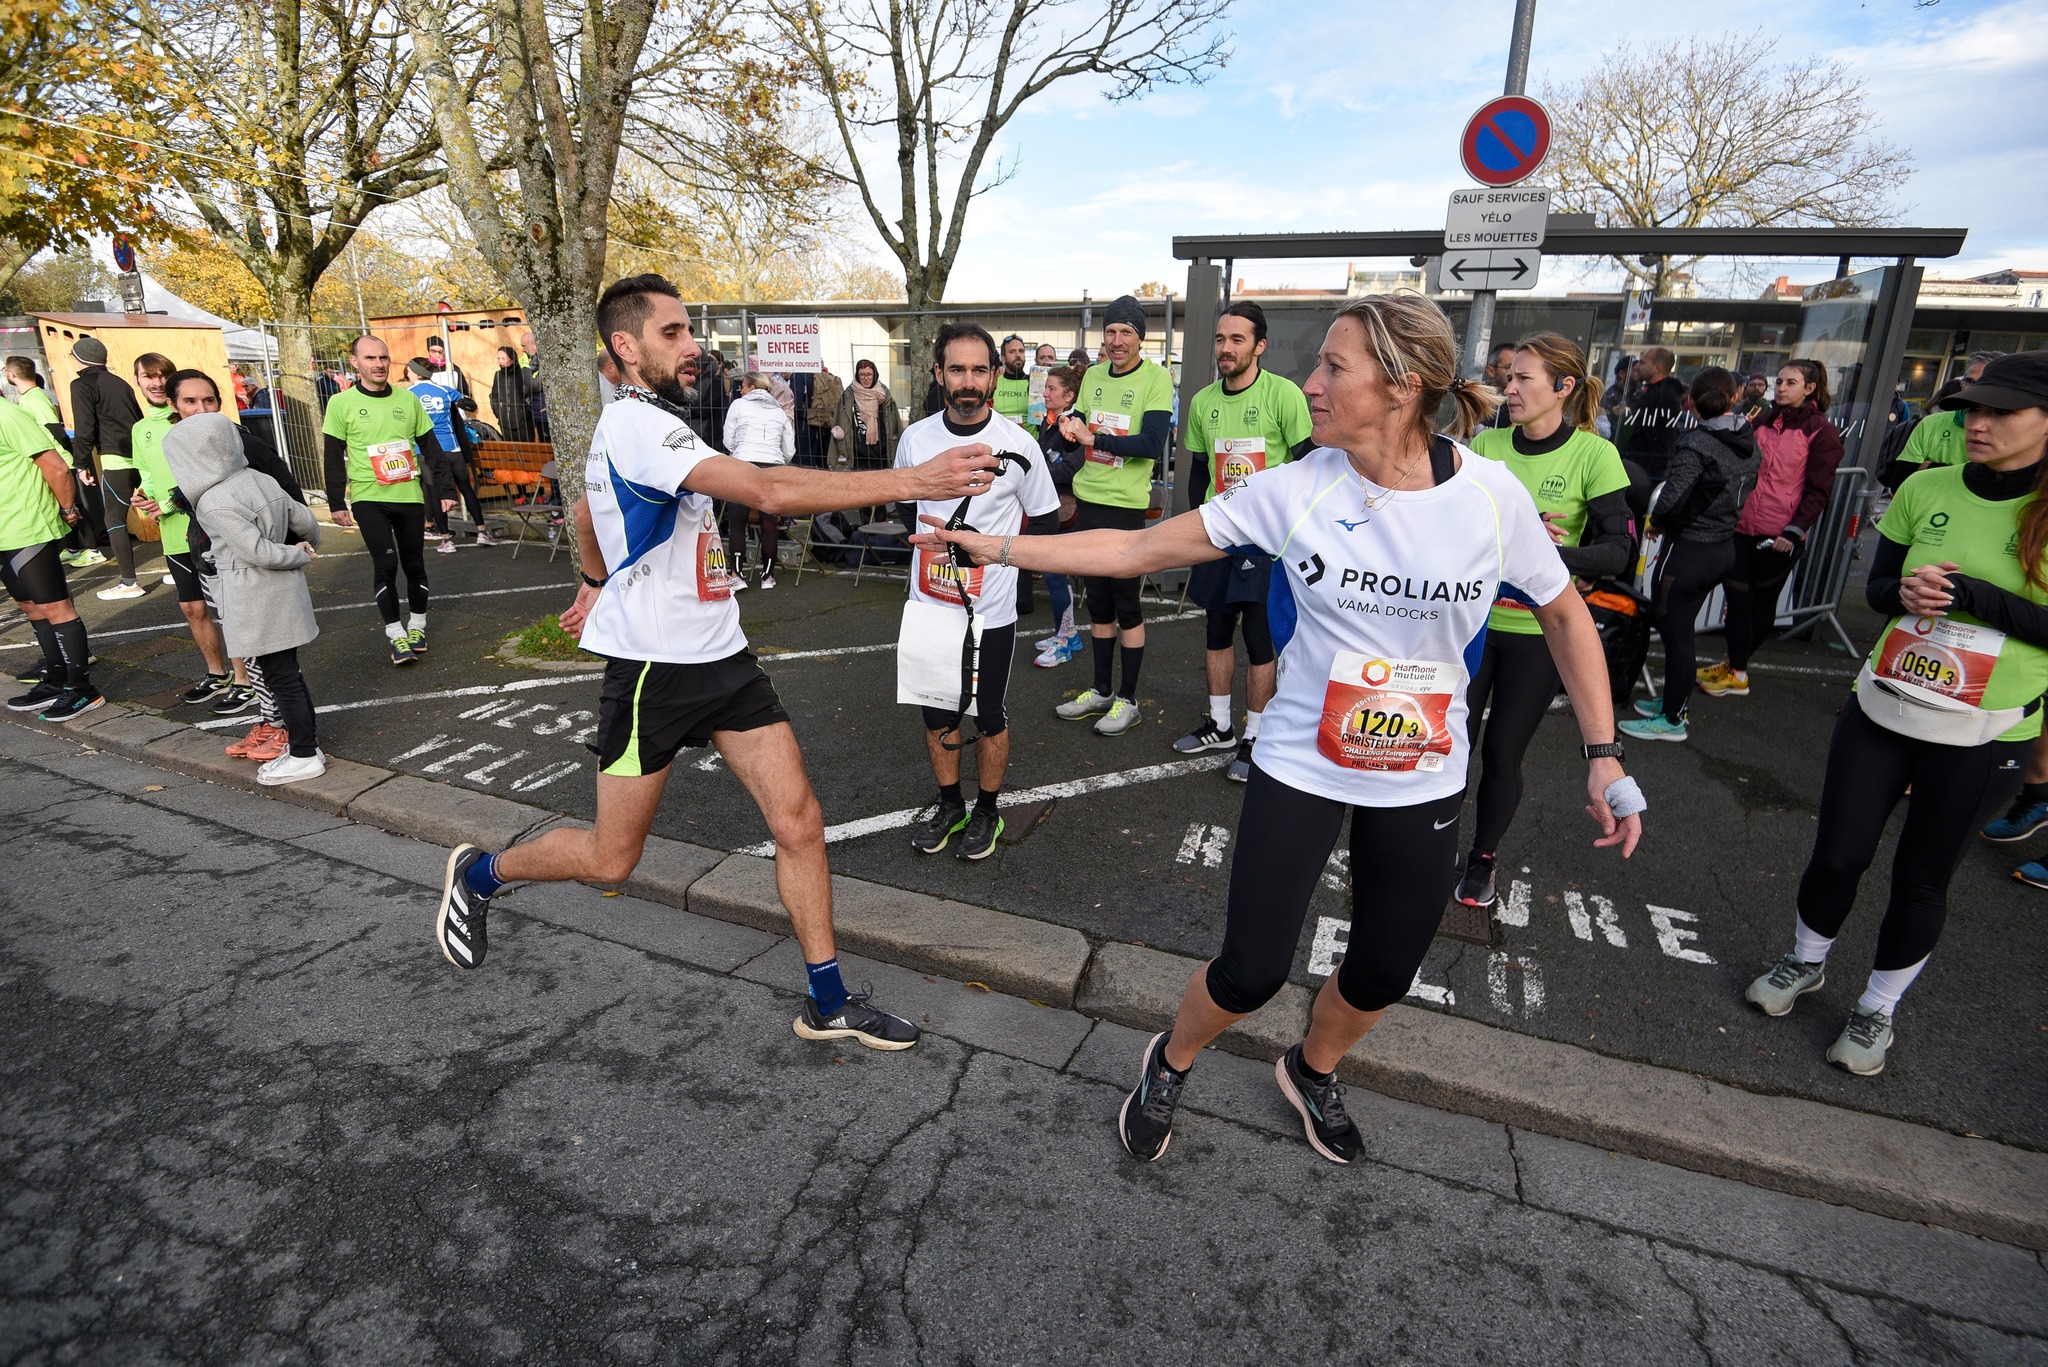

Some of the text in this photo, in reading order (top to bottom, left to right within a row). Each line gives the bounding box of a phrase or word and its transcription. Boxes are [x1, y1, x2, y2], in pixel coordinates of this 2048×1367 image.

[1453, 192, 1545, 204] SAUF SERVICES
[1481, 212, 1511, 222] YÉLO
[1450, 232, 1537, 242] LES MOUETTES
[757, 324, 818, 335] ZONE RELAIS
[768, 342, 809, 353] ENTREE
[760, 359, 783, 367] Réservée
[386, 460, 400, 471] 107
[1226, 463, 1248, 476] 155 4
[1340, 568, 1483, 602] PROLIANS
[1337, 598, 1439, 620] VAMA DOCKS
[1937, 620, 1977, 635] Harmonie
[1935, 627, 1975, 641] mutuelle
[1395, 663, 1437, 674] Harmonie
[1902, 651, 1954, 686] 069 3
[1394, 671, 1436, 681] mutuelle
[1355, 694, 1385, 709] EDITION
[1360, 709, 1404, 738] 120
[1407, 722, 1419, 738] 3
[1341, 733, 1395, 749] CHRISTELLE
[1398, 741, 1406, 749] LE
[1344, 746, 1421, 758] CHALLENGE Entreprises
[1386, 761, 1406, 770] NIORT
